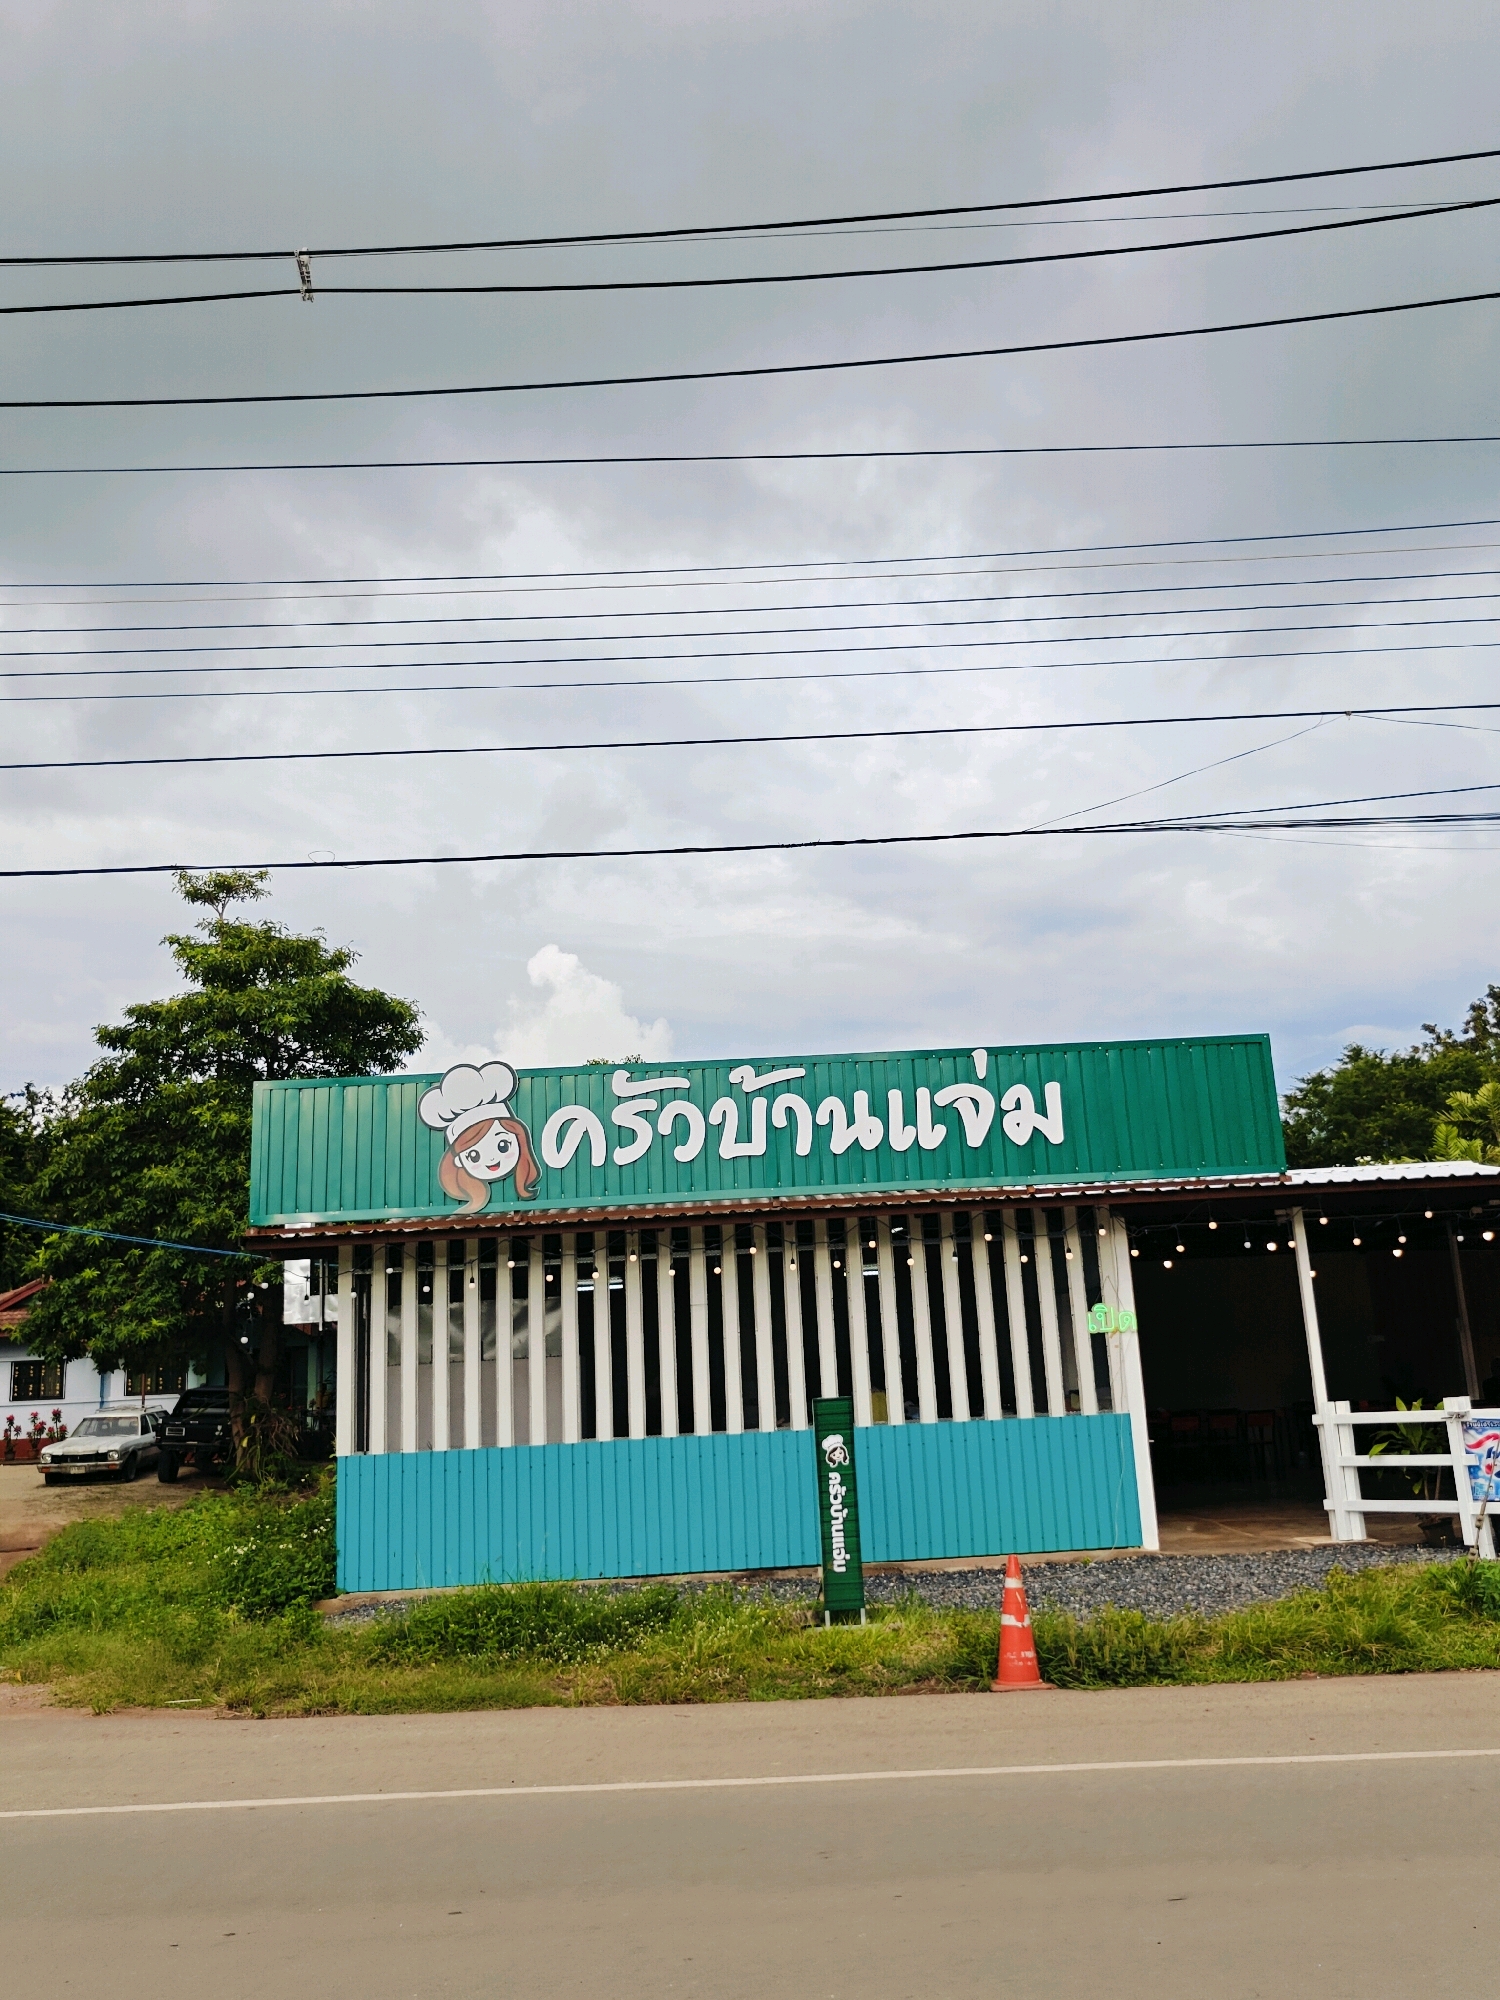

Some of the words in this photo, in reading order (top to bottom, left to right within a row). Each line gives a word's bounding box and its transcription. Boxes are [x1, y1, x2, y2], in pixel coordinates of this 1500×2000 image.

[541, 1048, 1065, 1170] ครัวบ้านแจ่ม
[1087, 1303, 1137, 1333] เปิด
[828, 1471, 851, 1573] ครัวบ้านแจ่ม
